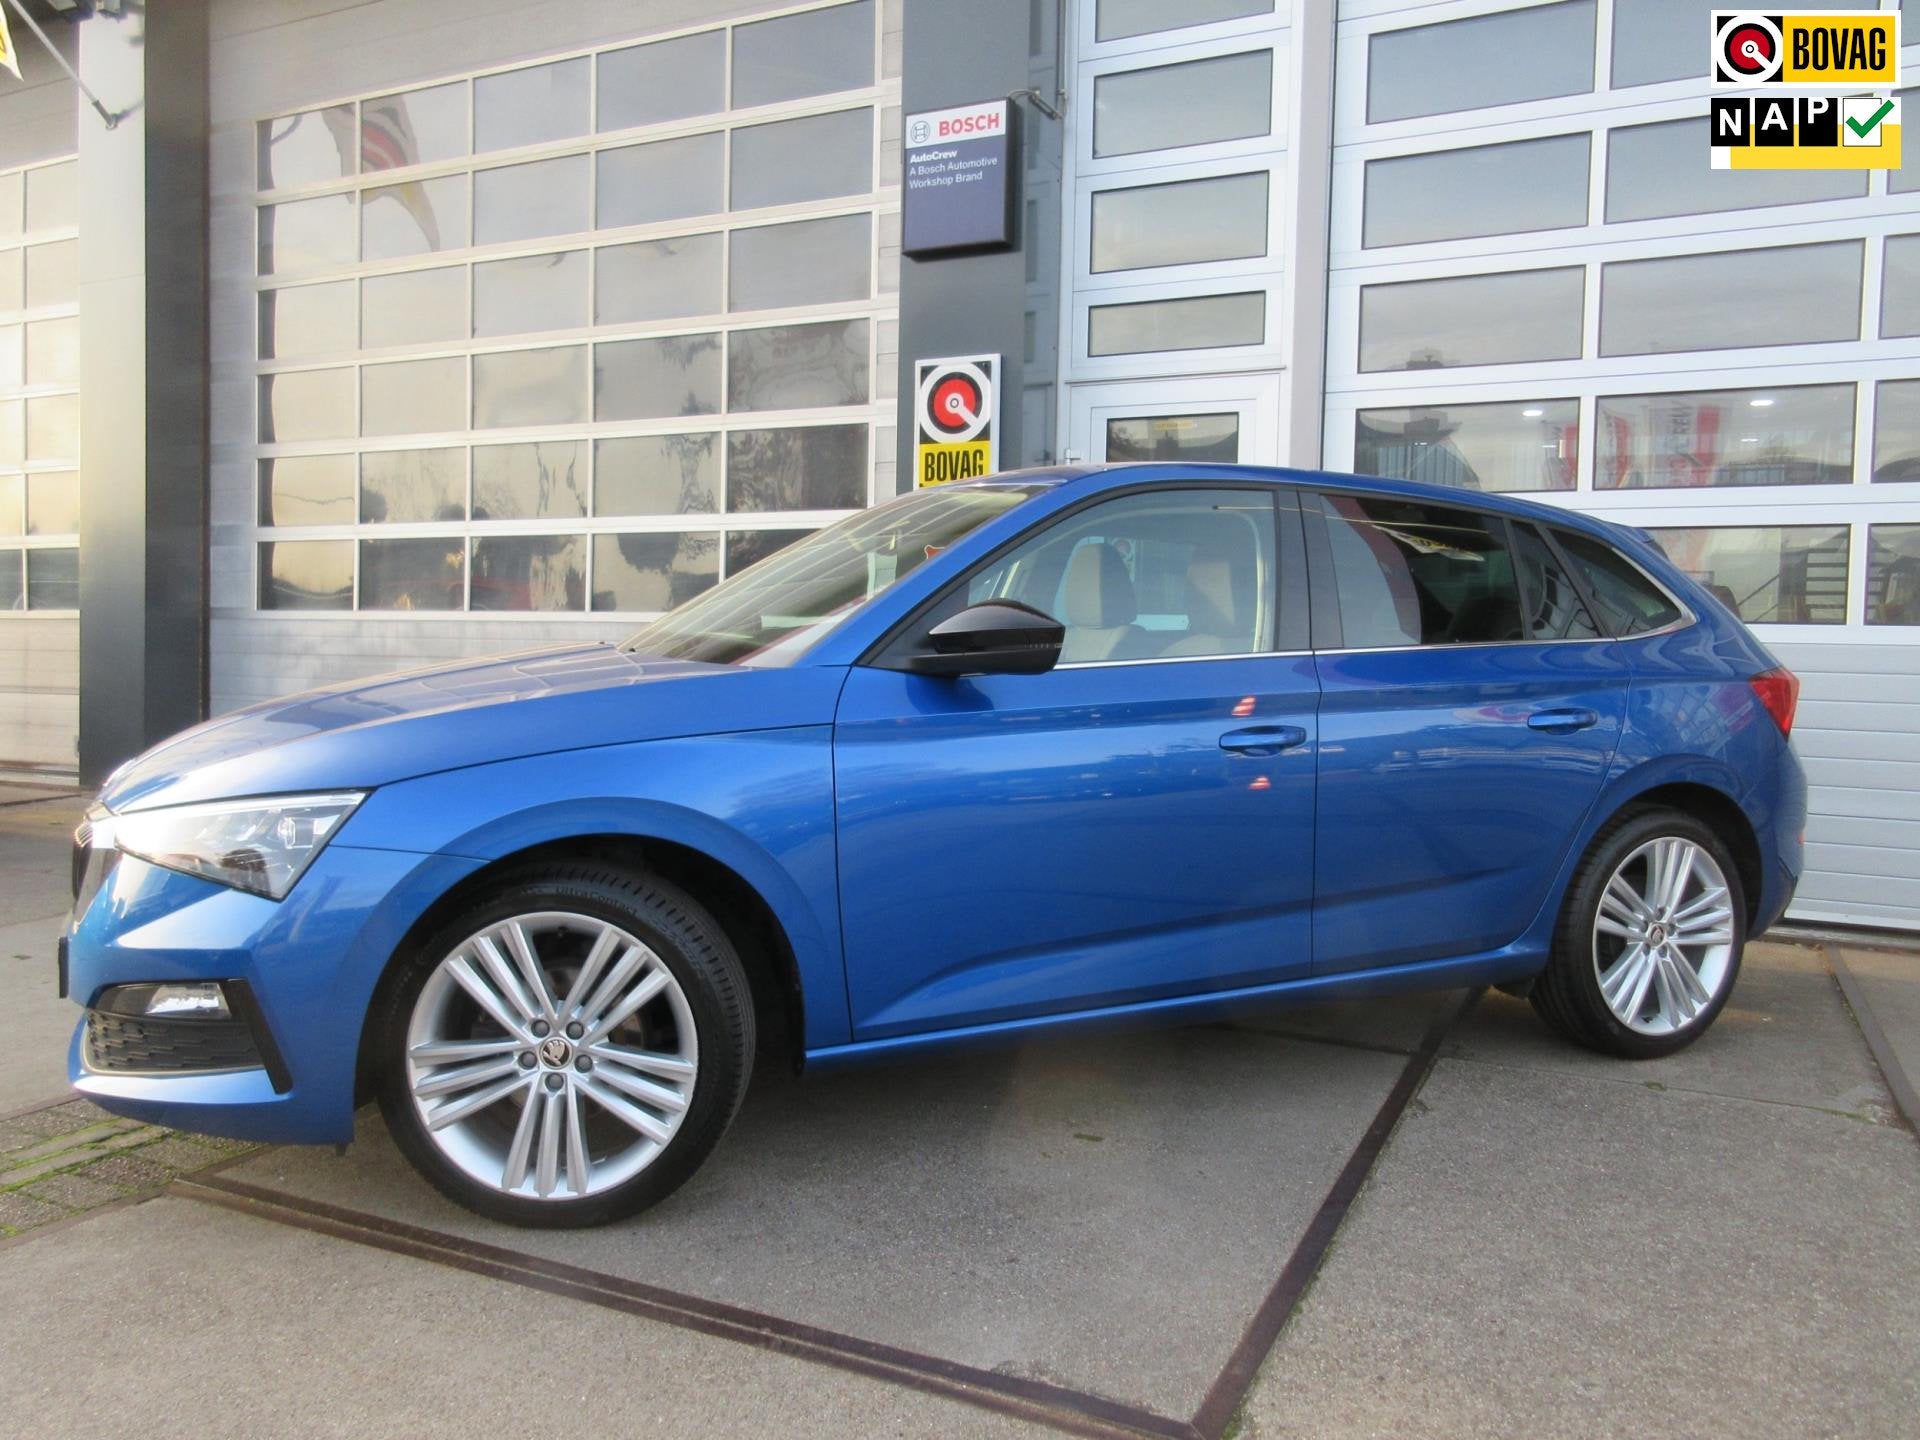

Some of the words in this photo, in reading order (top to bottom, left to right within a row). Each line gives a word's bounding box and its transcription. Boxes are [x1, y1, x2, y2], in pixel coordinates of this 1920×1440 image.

[939, 113, 999, 136] BOSCH
[910, 151, 957, 163] AutoCrew
[910, 167, 916, 176] A
[918, 163, 945, 175] Bosch
[947, 157, 997, 172] Automotive
[909, 175, 954, 190] Workshop
[955, 171, 983, 183] Brand
[924, 448, 984, 482] BOVAG
